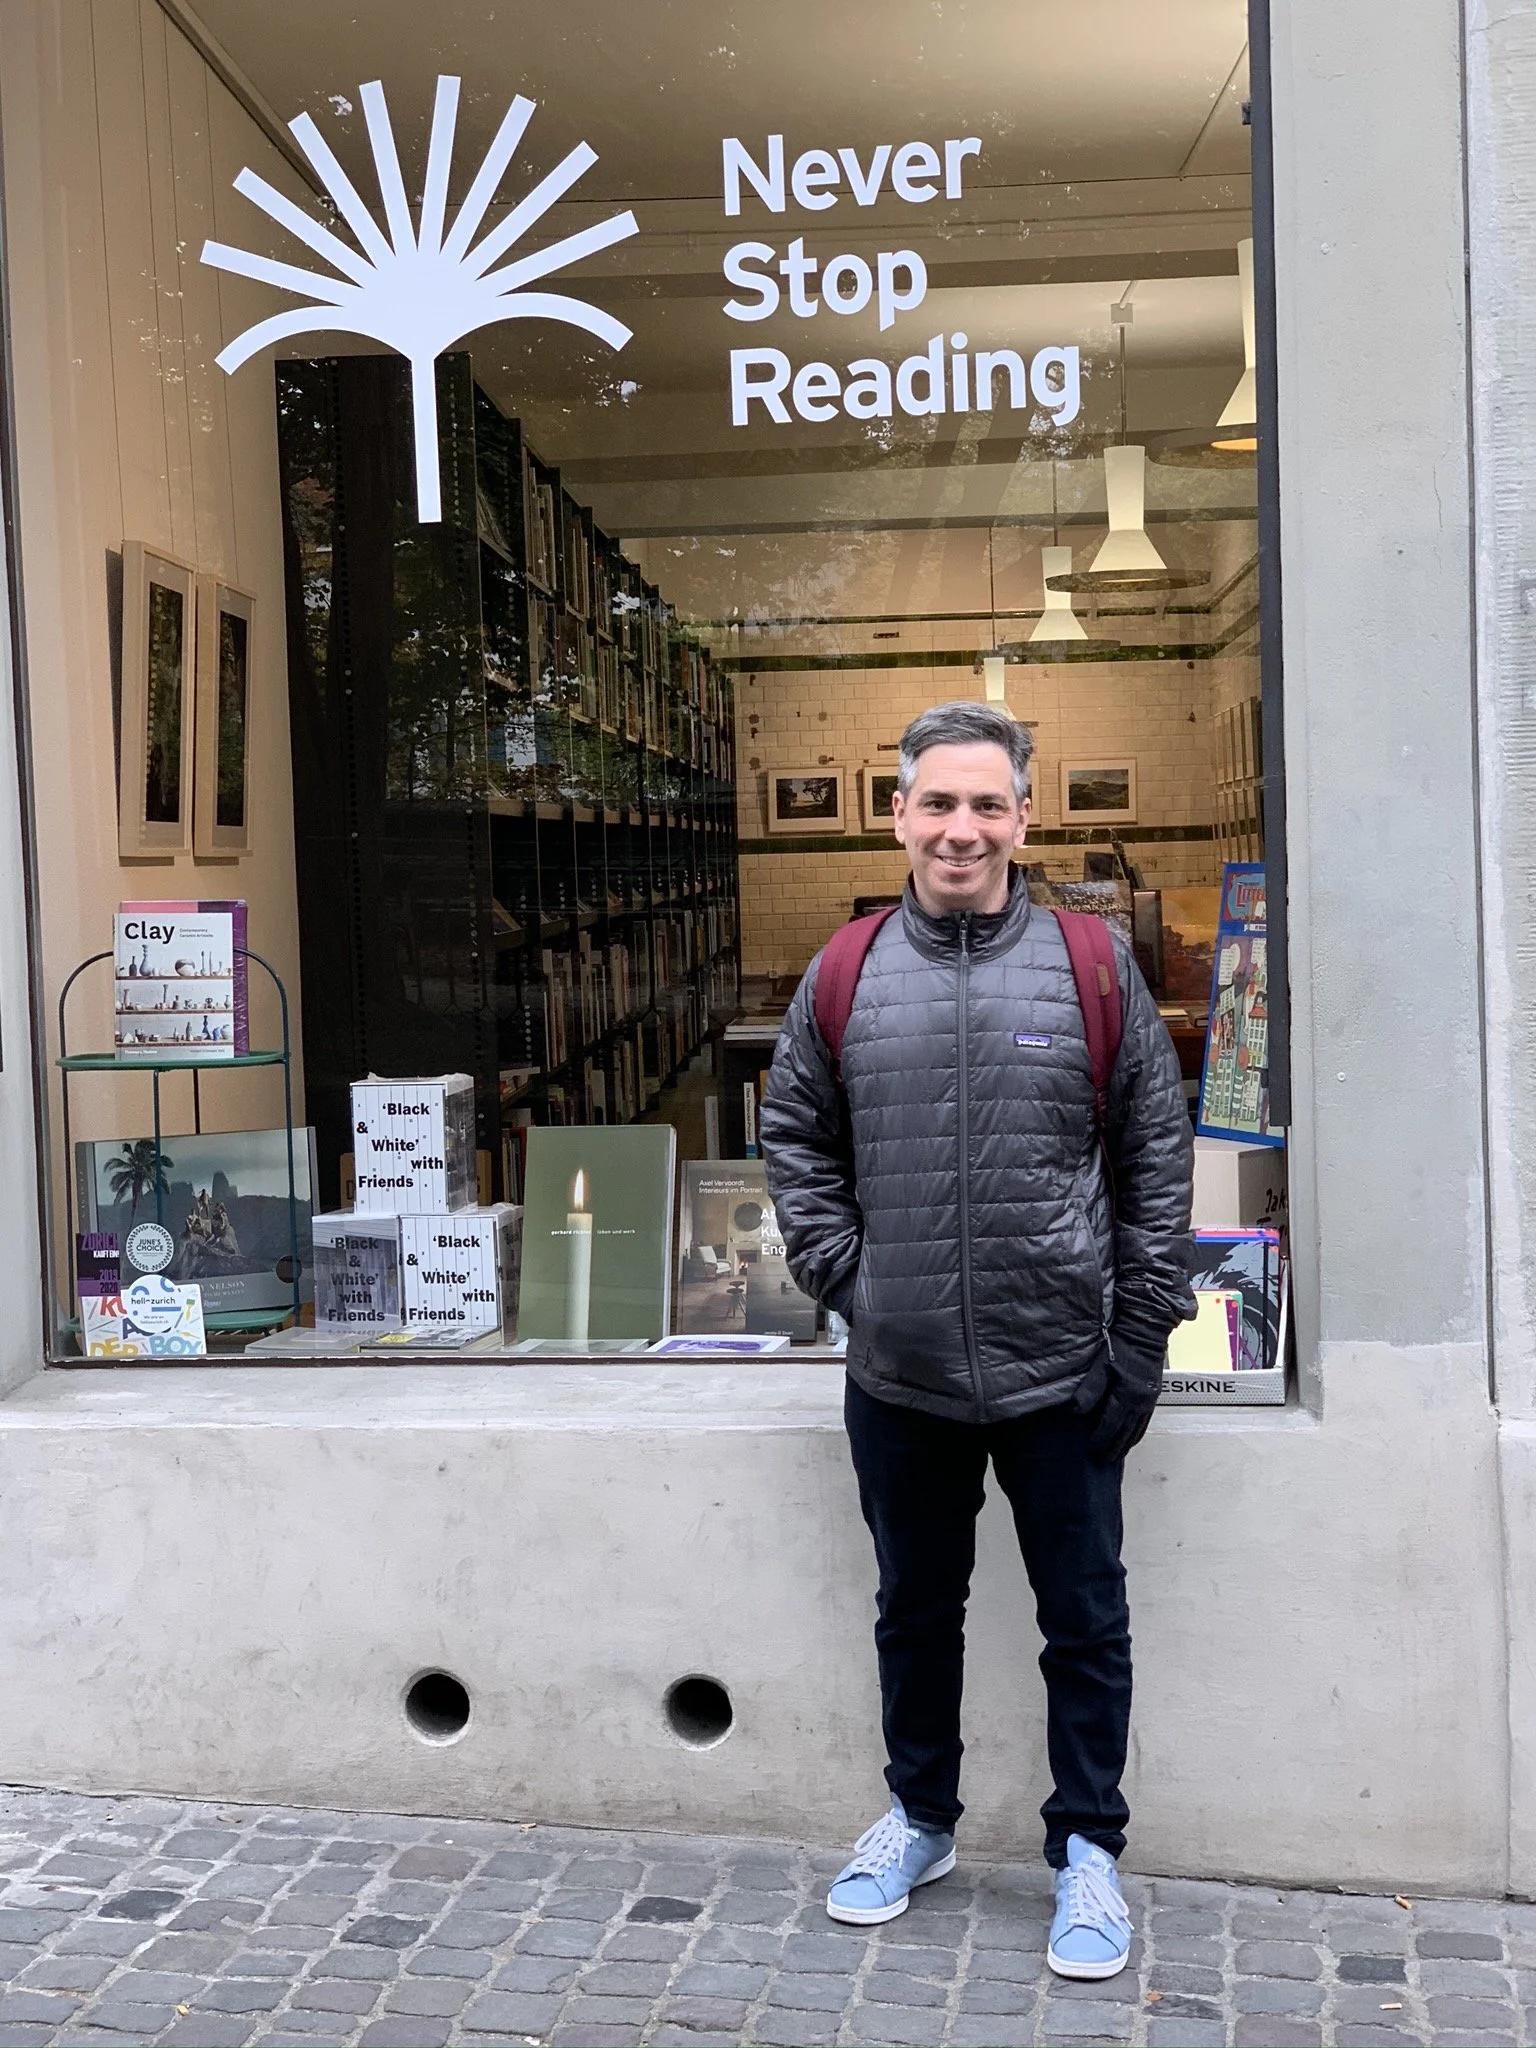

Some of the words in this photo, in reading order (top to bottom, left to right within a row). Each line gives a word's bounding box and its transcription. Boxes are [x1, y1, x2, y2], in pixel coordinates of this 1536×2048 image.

[722, 133, 982, 216] Never
[722, 236, 928, 332] Stop
[730, 331, 1081, 427] Reading
[124, 920, 175, 945] Clay
[356, 1121, 368, 1134] &
[410, 1155, 444, 1170] with
[358, 1174, 414, 1188] Friends
[698, 1179, 713, 1187] Axel
[714, 1179, 745, 1187] Vervoordt
[348, 1254, 361, 1267] &
[406, 1253, 418, 1266] &
[99, 1269, 119, 1280] 2019
[99, 1281, 119, 1294] 2020
[209, 1280, 245, 1290] NELSON
[339, 1290, 373, 1304] with
[462, 1288, 495, 1302] with
[328, 1307, 386, 1322] Friends
[408, 1306, 466, 1321] Friends
[1161, 1380, 1236, 1393] ESKINE
